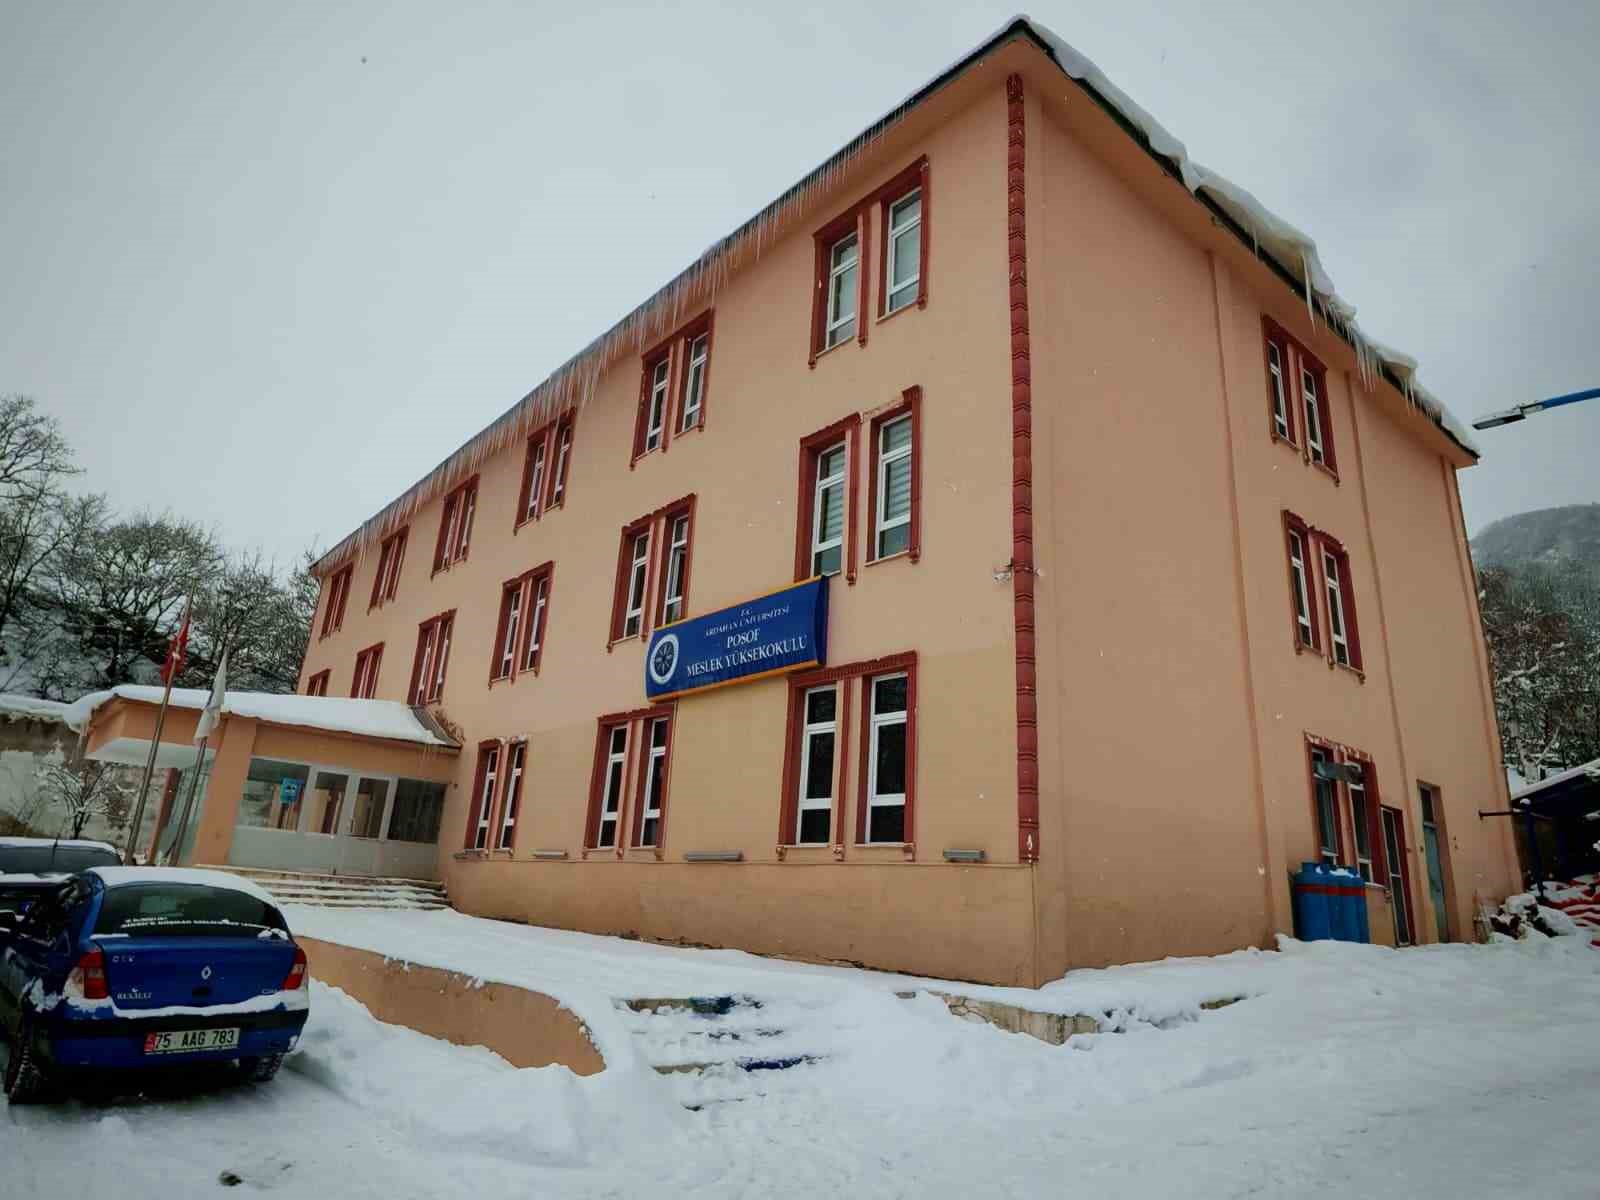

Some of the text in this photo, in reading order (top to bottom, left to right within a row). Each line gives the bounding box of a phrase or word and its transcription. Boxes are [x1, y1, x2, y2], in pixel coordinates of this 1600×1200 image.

[705, 621, 738, 636] ARDAHAN
[727, 628, 761, 649] POSOF
[686, 634, 808, 678] MESLEK YÜKSEKOKULU
[155, 1030, 235, 1049] 75 AAG 783
